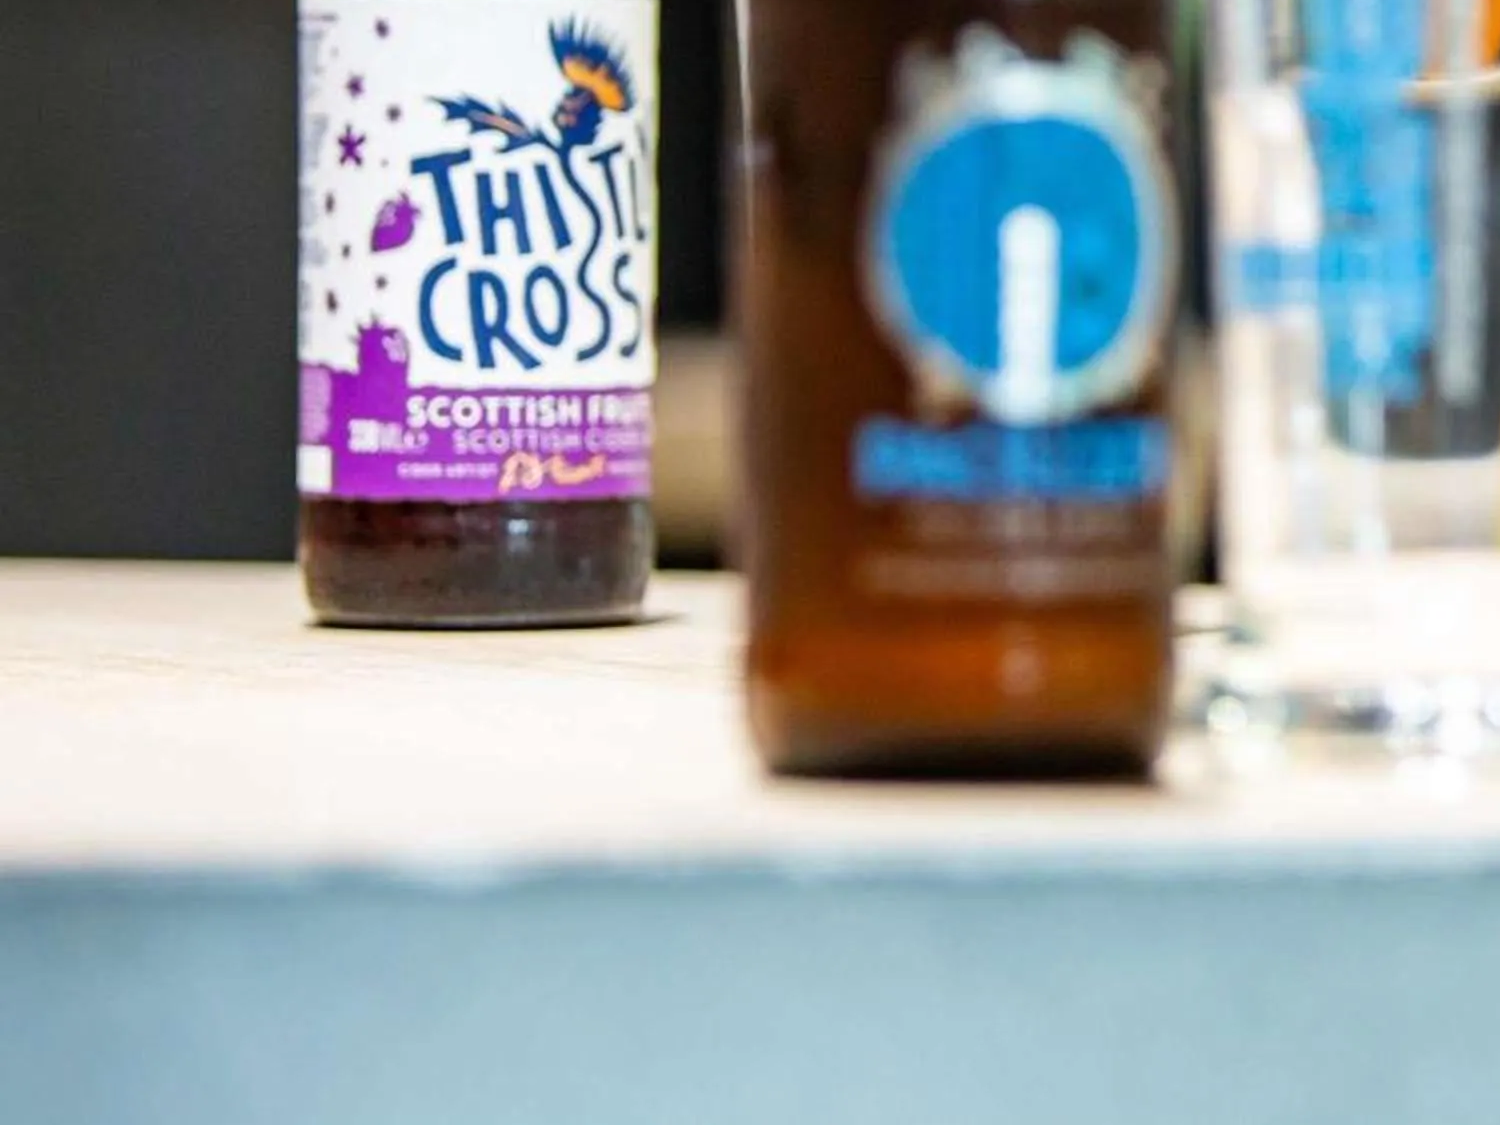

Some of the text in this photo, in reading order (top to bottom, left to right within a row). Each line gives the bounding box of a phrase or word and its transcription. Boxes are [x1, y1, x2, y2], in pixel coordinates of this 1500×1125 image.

[417, 251, 641, 370] CROSS
[406, 395, 582, 428] SCOTTISH
[452, 427, 582, 455] SCOTTISH
